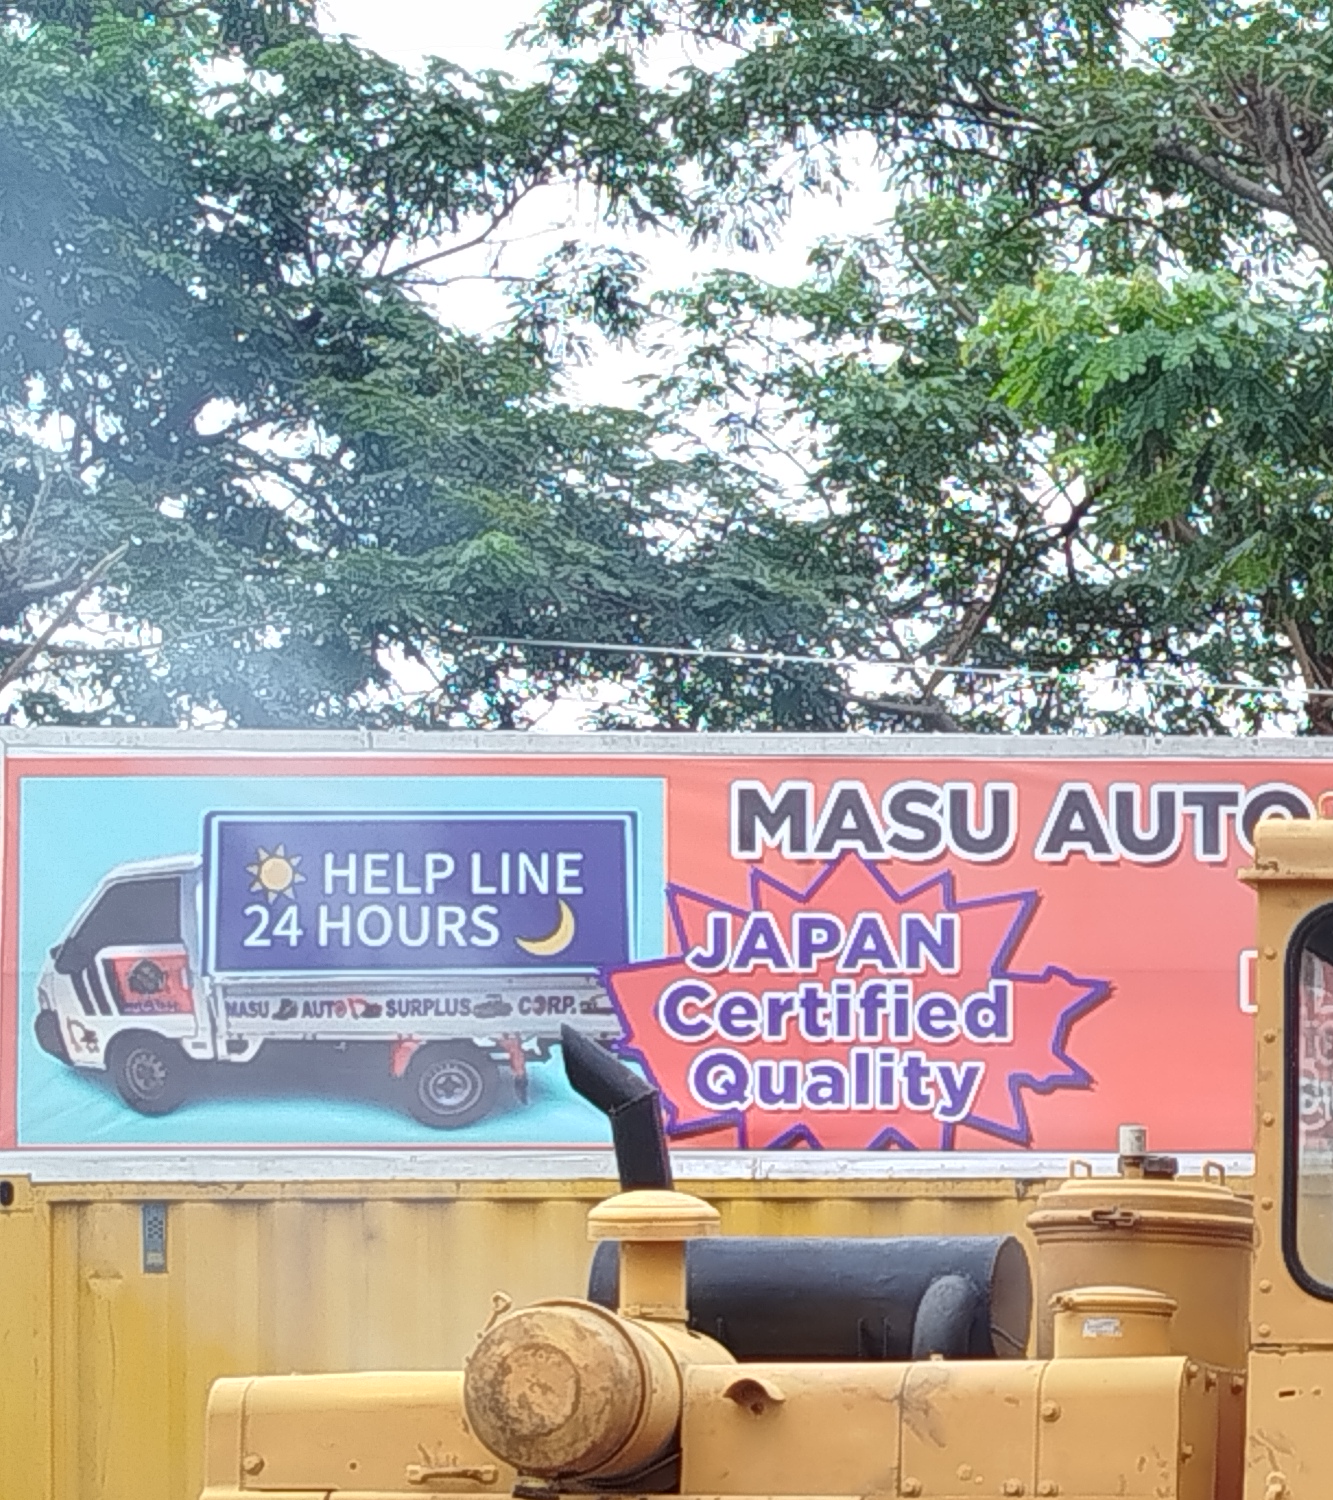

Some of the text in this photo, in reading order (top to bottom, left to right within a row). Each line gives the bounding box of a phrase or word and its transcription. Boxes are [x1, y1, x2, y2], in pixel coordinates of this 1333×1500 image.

[733, 783, 1014, 857] MASU
[1037, 783, 1315, 857] AUTO
[324, 852, 584, 896] HELP LINE
[243, 904, 500, 948] 24 HOURS
[690, 914, 957, 971] JAPAN
[226, 995, 577, 1018] MASU AUTO SURPLUS CORP.
[662, 980, 1009, 1040] Certified
[693, 1051, 984, 1119] Quality
